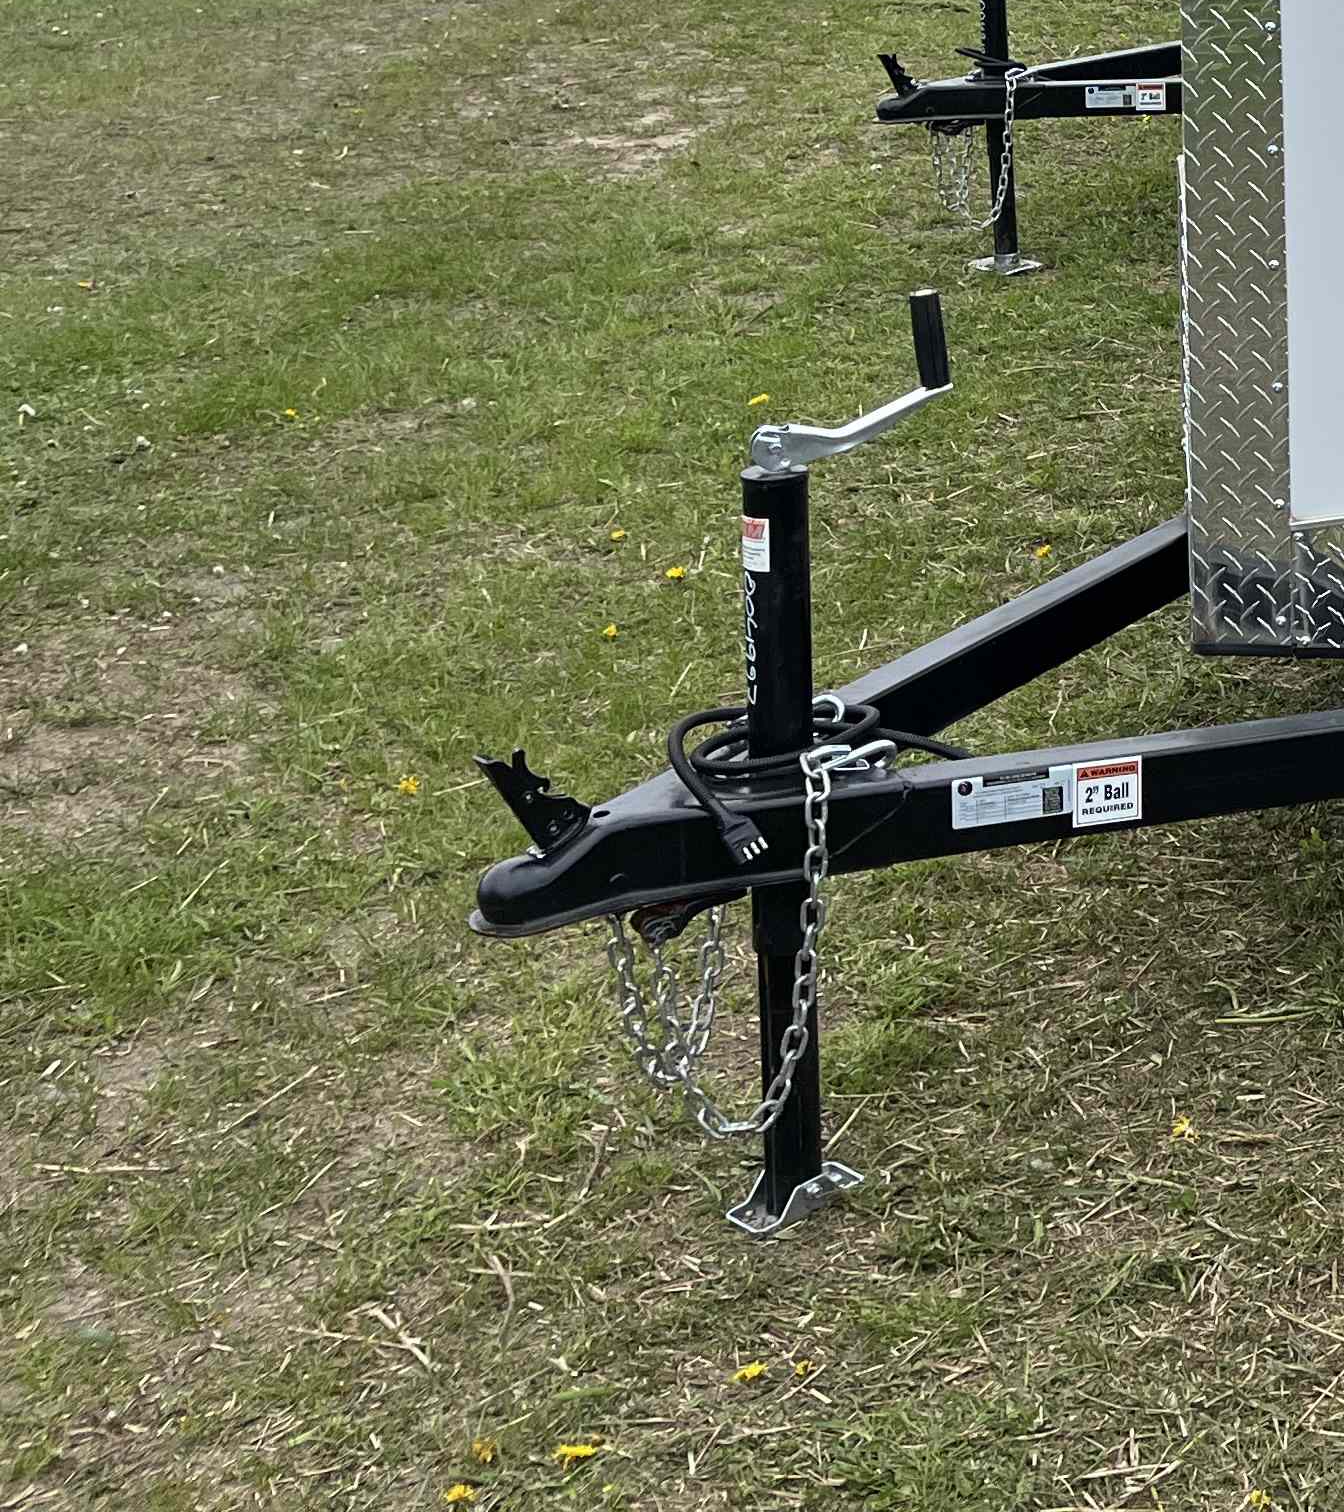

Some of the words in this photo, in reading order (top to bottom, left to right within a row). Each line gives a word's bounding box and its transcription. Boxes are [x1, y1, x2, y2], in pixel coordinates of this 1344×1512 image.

[1090, 764, 1136, 777] WARNING
[1104, 781, 1129, 801] Ball
[1081, 802, 1134, 816] REQUIRED
